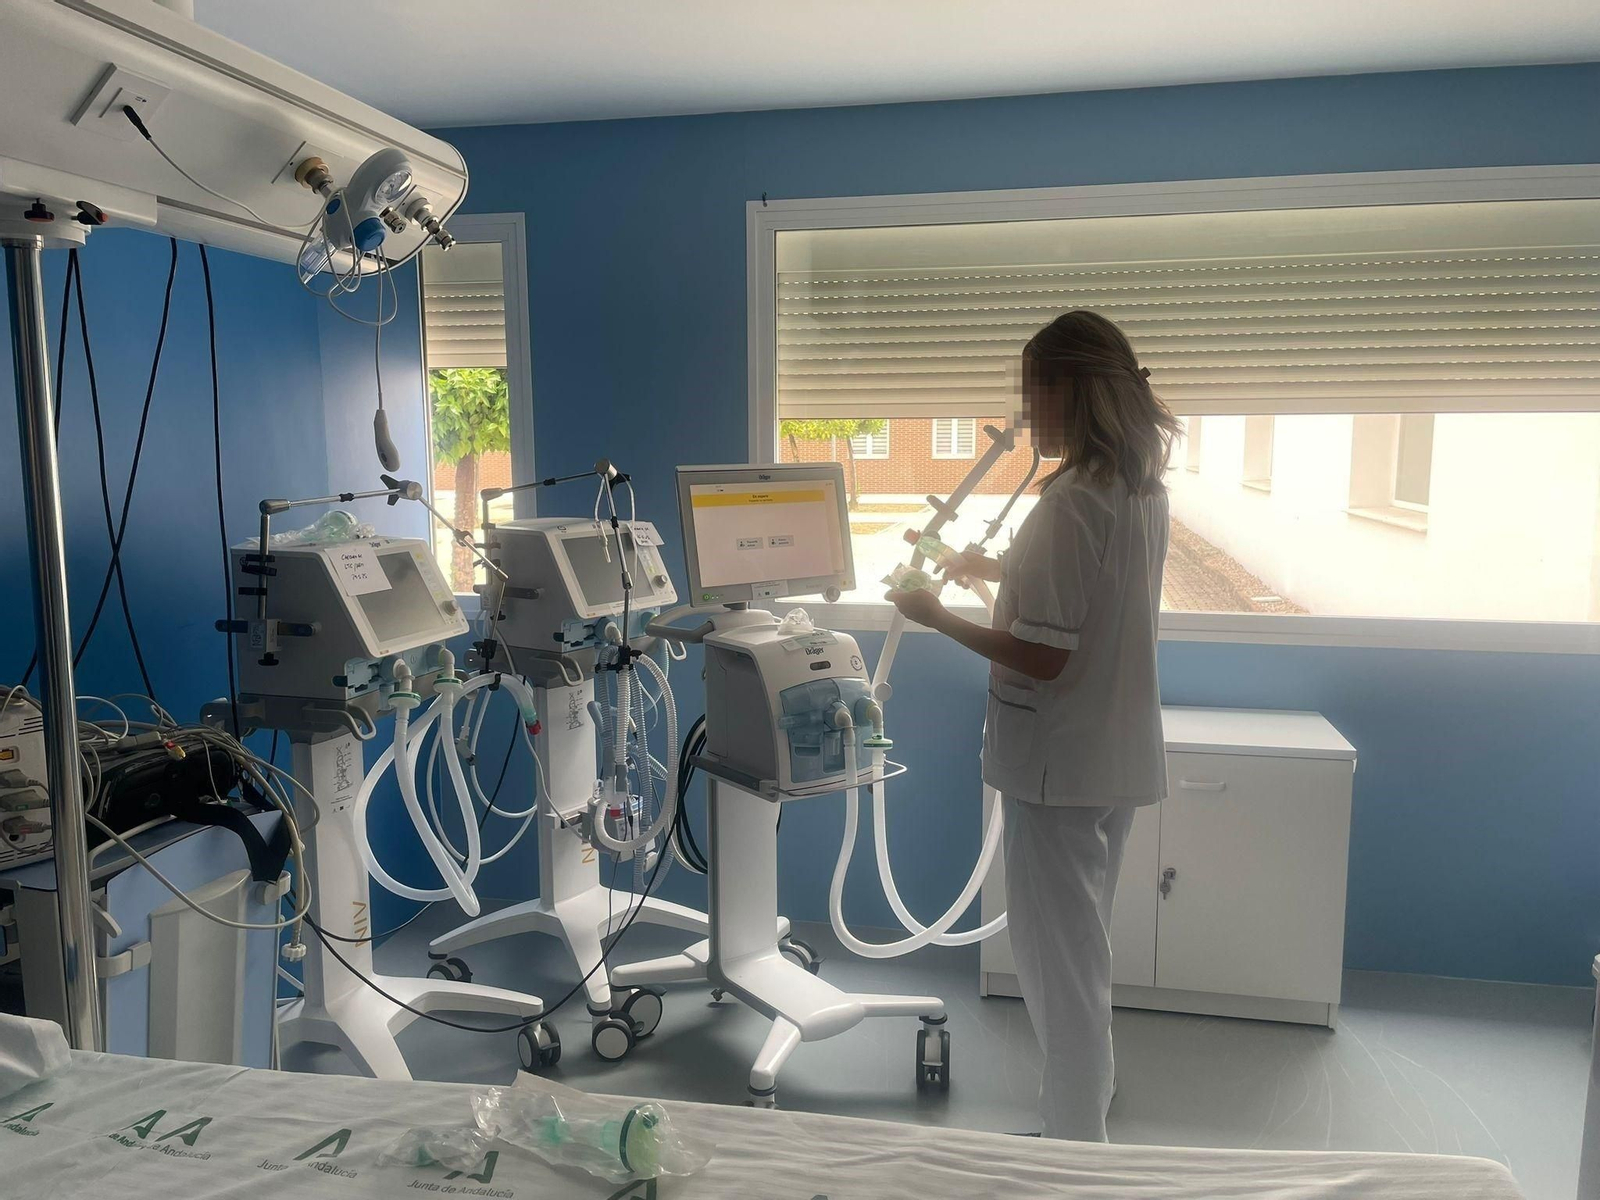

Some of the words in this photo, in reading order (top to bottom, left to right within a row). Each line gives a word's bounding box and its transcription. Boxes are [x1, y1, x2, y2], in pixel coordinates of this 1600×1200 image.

[407, 1179, 440, 1191] Junta
[441, 1185, 456, 1193] de
[459, 1186, 514, 1199] Andalucía
